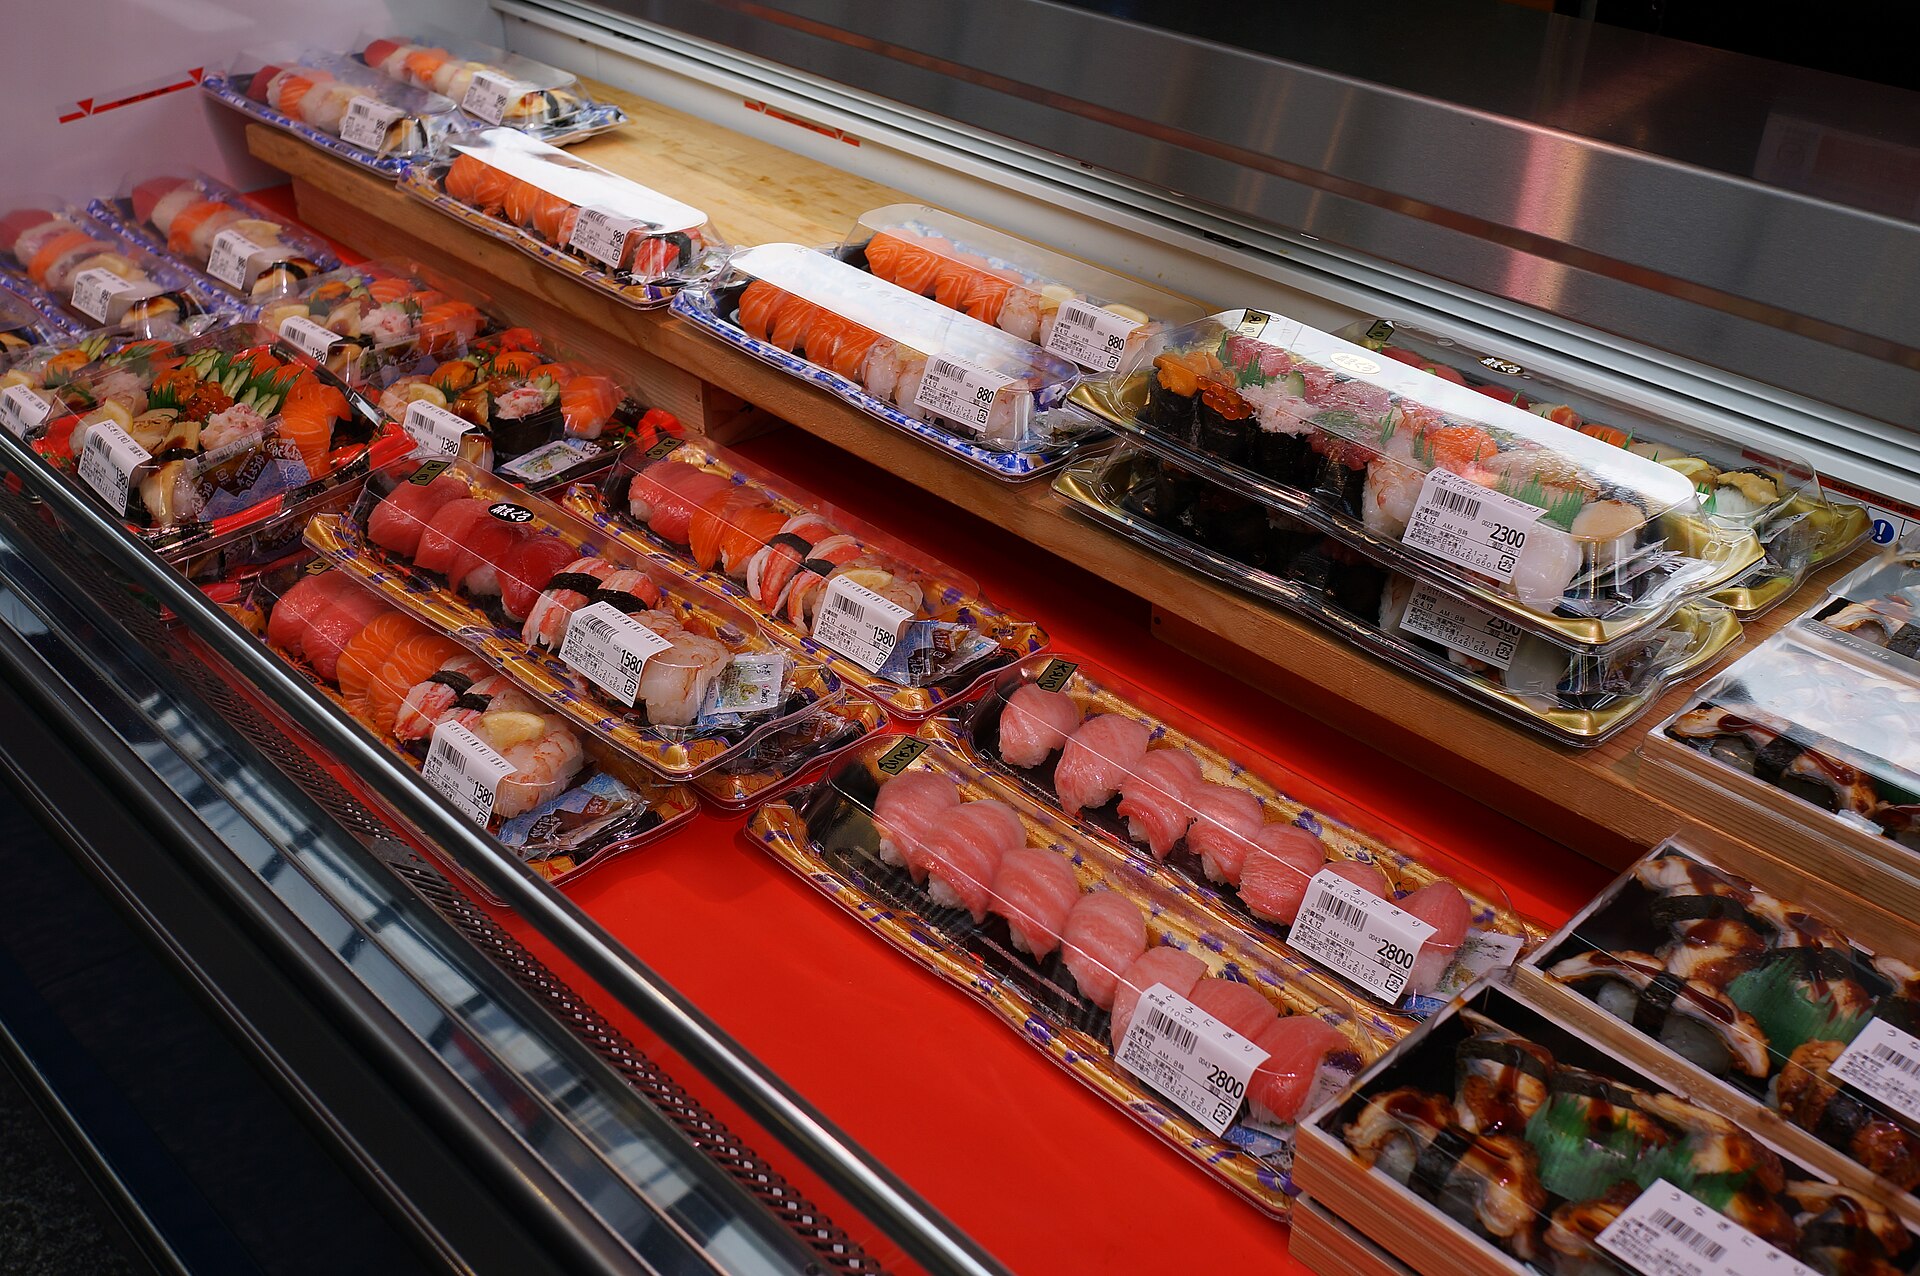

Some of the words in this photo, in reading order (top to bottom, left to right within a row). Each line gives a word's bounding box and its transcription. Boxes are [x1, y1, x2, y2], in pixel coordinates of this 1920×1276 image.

[312, 347, 326, 362] 1380
[1107, 334, 1124, 351] 880
[1480, 357, 1521, 373] 本まぐろ
[977, 387, 995, 403] 880
[441, 437, 458, 454] 1380
[1831, 481, 1865, 501] SAFETY
[1868, 494, 1891, 508] LOAD
[1895, 504, 1914, 515] LINE
[491, 504, 531, 522] 本まぐろ
[1490, 523, 1525, 549] 2300
[873, 627, 895, 647] 1580
[620, 649, 643, 674] 1580
[885, 743, 918, 769] 大とろ
[474, 781, 494, 807] 1580
[1333, 878, 1421, 928] とろにぎり
[1377, 938, 1414, 970] 2800
[1165, 993, 1253, 1052] とろにぎり
[1207, 1064, 1244, 1099] 2800
